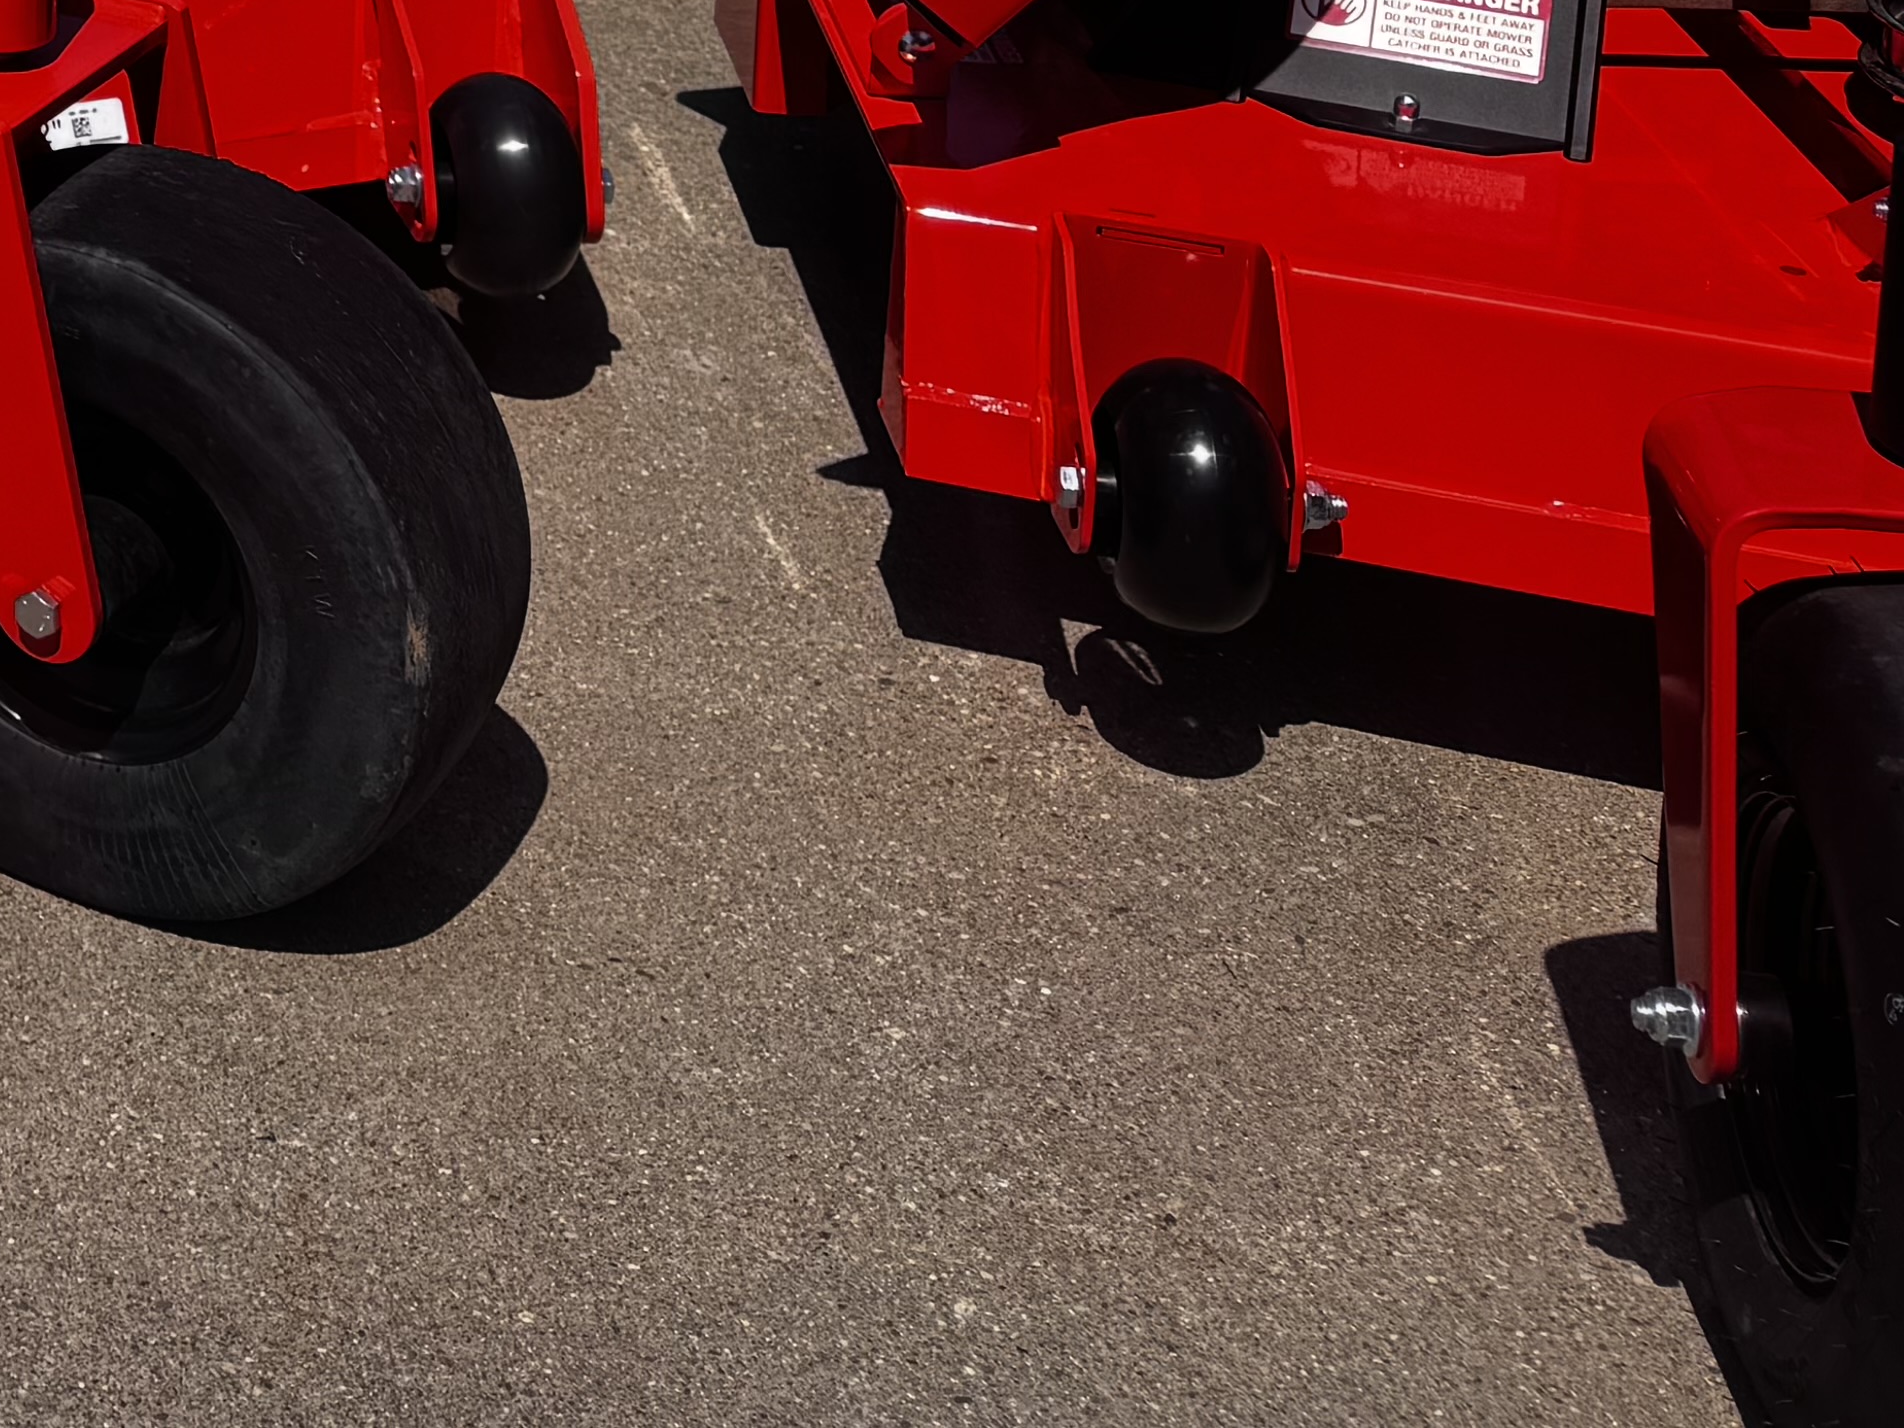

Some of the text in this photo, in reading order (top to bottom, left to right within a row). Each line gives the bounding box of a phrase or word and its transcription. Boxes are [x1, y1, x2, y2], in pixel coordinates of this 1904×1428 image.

[1382, 0, 1411, 11] KEEP
[1415, 4, 1454, 18] HANDS
[1471, 13, 1498, 25] FEET
[1380, 24, 1534, 58] UNLESS GUARD OR GRASS
[1384, 12, 1533, 45] DO NOT OPERATE MOWER
[1387, 37, 1441, 55] CATCHER
